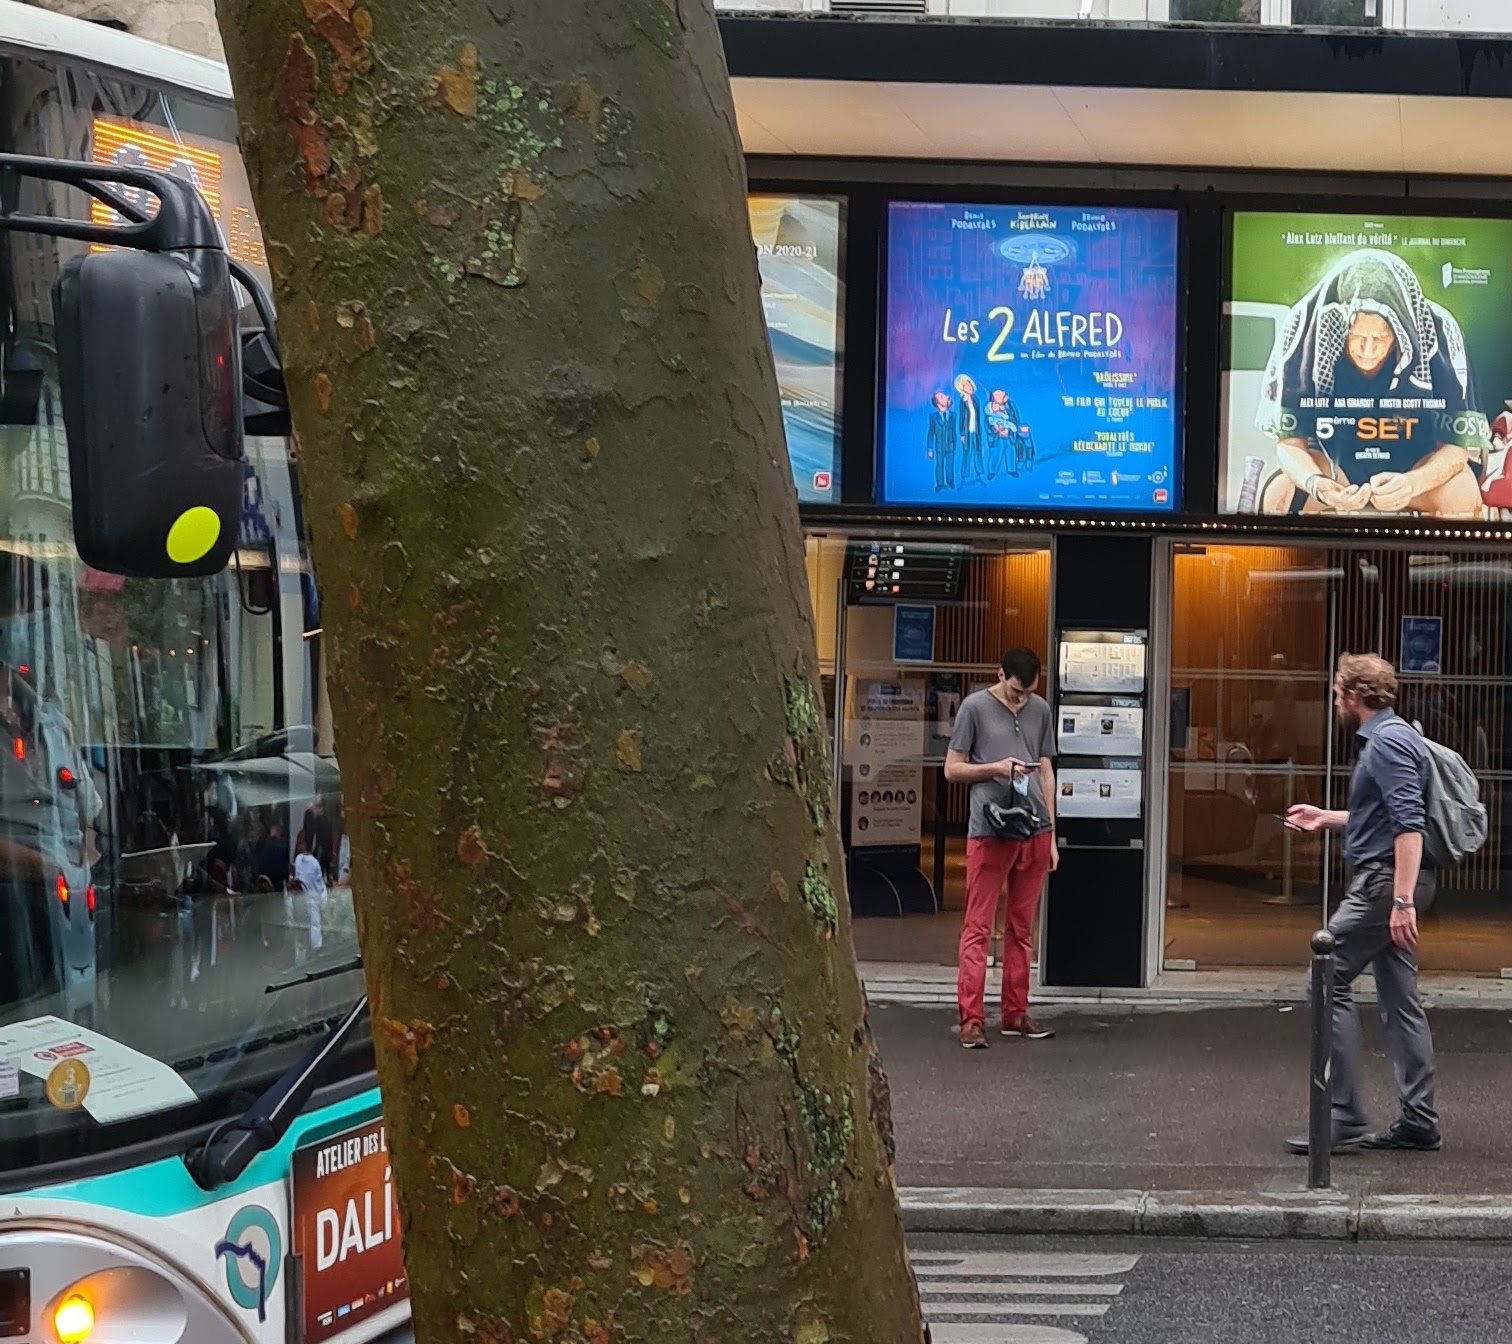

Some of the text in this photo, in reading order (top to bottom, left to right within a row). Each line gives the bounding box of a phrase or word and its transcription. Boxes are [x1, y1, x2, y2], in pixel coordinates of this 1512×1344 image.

[775, 244, 818, 258] 2020-21
[1306, 233, 1323, 245] Lutz
[943, 306, 1123, 363] Les 2 ALFRED
[1356, 417, 1420, 441] SET
[316, 1137, 361, 1178] ATELIER
[363, 1133, 379, 1157] DES
[316, 1165, 392, 1272] DALÍ
